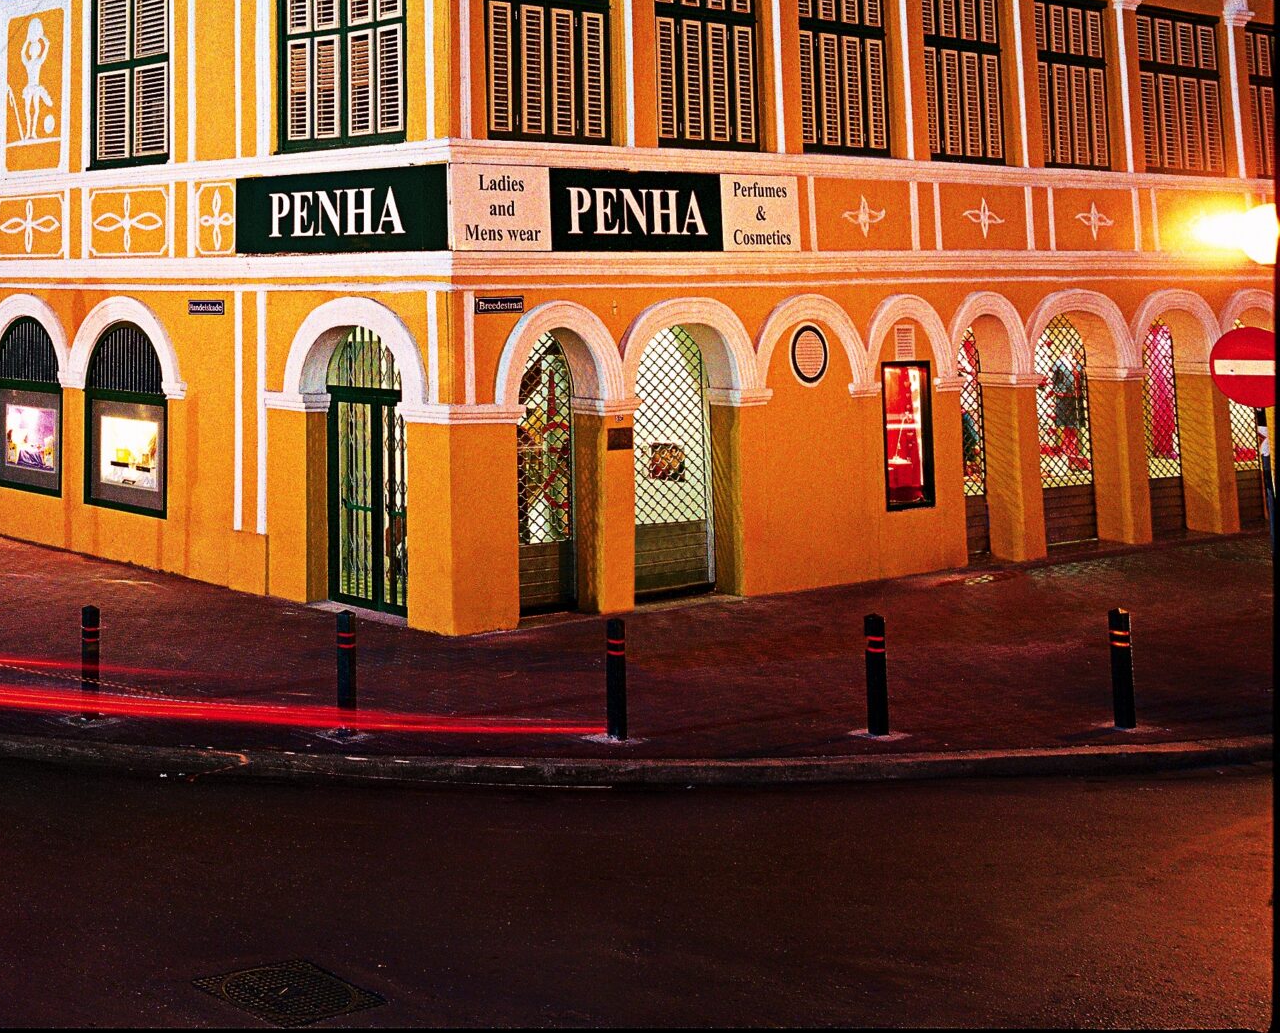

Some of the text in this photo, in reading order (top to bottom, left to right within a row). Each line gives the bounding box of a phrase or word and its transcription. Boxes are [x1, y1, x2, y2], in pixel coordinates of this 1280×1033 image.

[478, 174, 525, 192] Ladies
[733, 181, 788, 198] Perfumes
[268, 185, 407, 238] PENHA
[489, 200, 516, 217] and
[565, 186, 709, 236] PENHA
[755, 205, 767, 221] &
[465, 224, 542, 242] Mens wear
[733, 229, 792, 246] Cosmetics
[479, 300, 523, 310] Breedestraat
